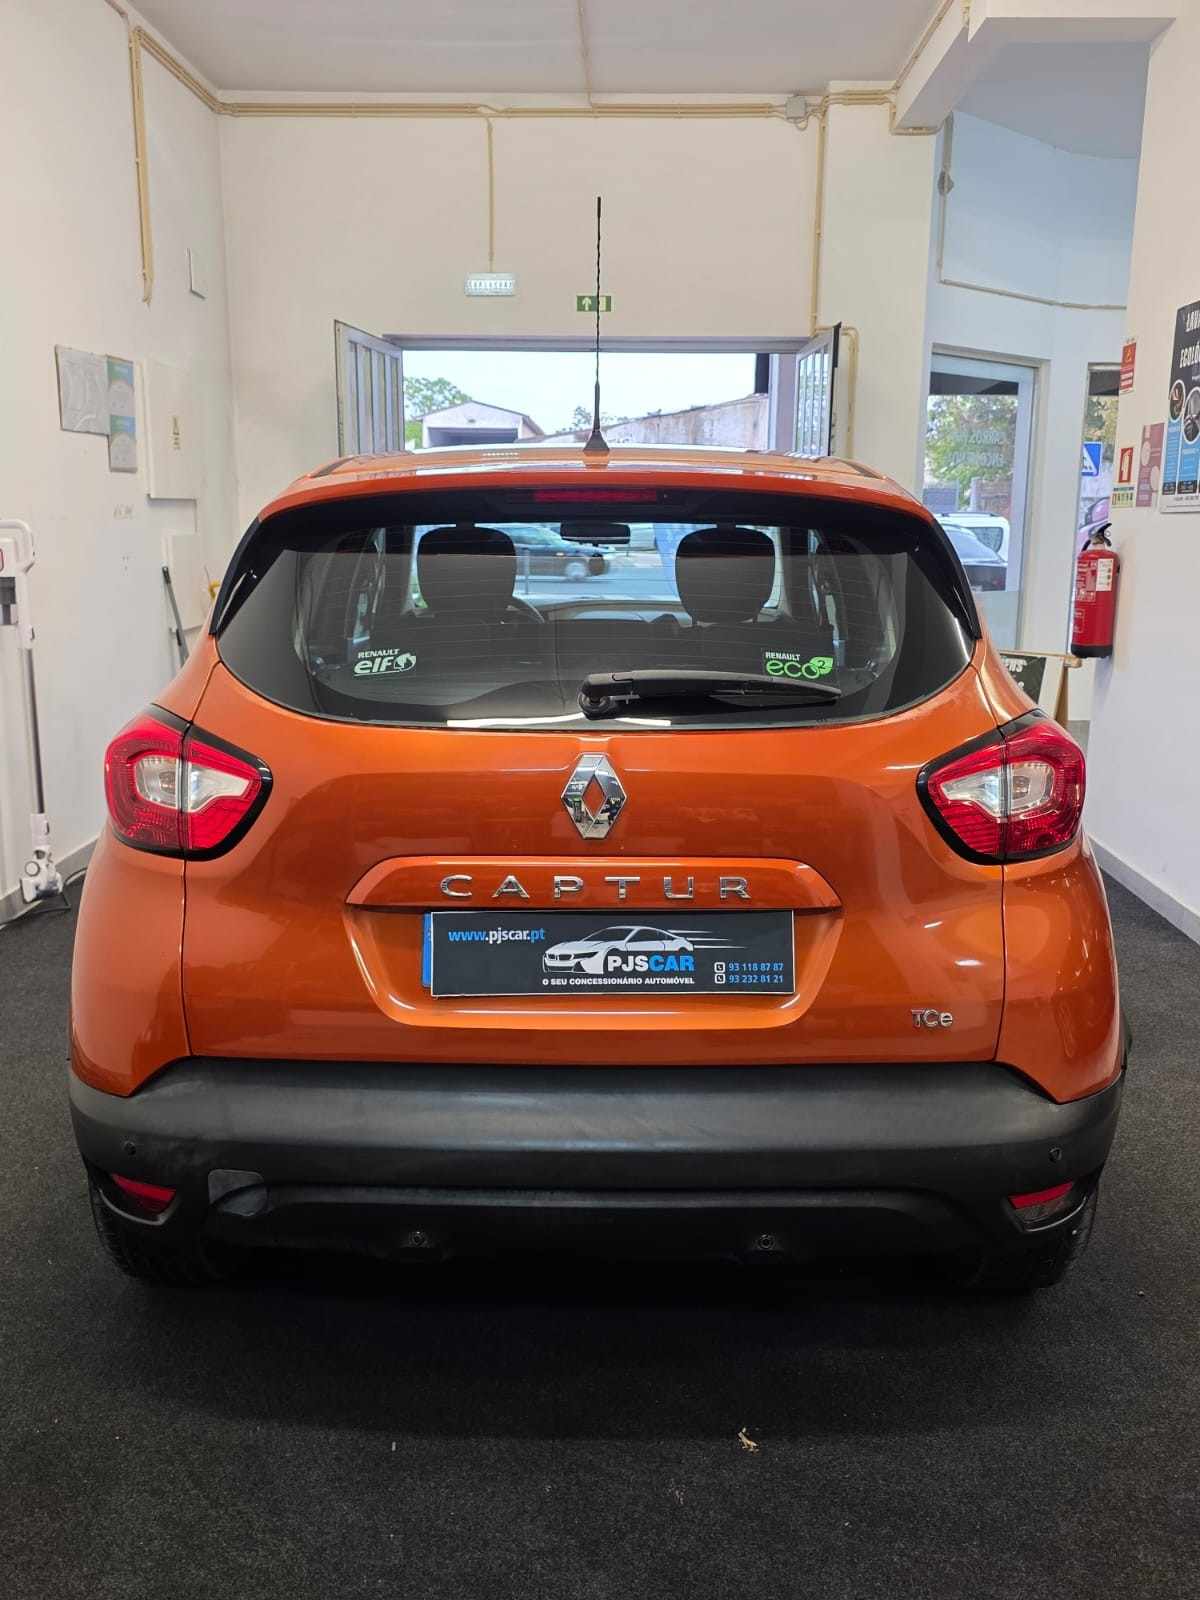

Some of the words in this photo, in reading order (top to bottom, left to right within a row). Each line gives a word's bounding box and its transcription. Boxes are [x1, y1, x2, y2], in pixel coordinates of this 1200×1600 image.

[1185, 310, 1200, 332] LAV
[1180, 340, 1200, 368] ECOLÓ
[358, 648, 400, 659] RENAULT
[765, 651, 800, 661] RENAULT
[440, 874, 752, 899] CAPTUR
[448, 927, 545, 944] www.pjscar.pt
[607, 954, 695, 972] PJSCAR
[728, 962, 740, 971] 93
[569, 976, 642, 985] CONCESSIONÁRIO
[645, 975, 695, 985] AUTOMÓVEL
[728, 974, 740, 983] 93
[772, 974, 784, 983] 21
[911, 1008, 953, 1027] TCe
